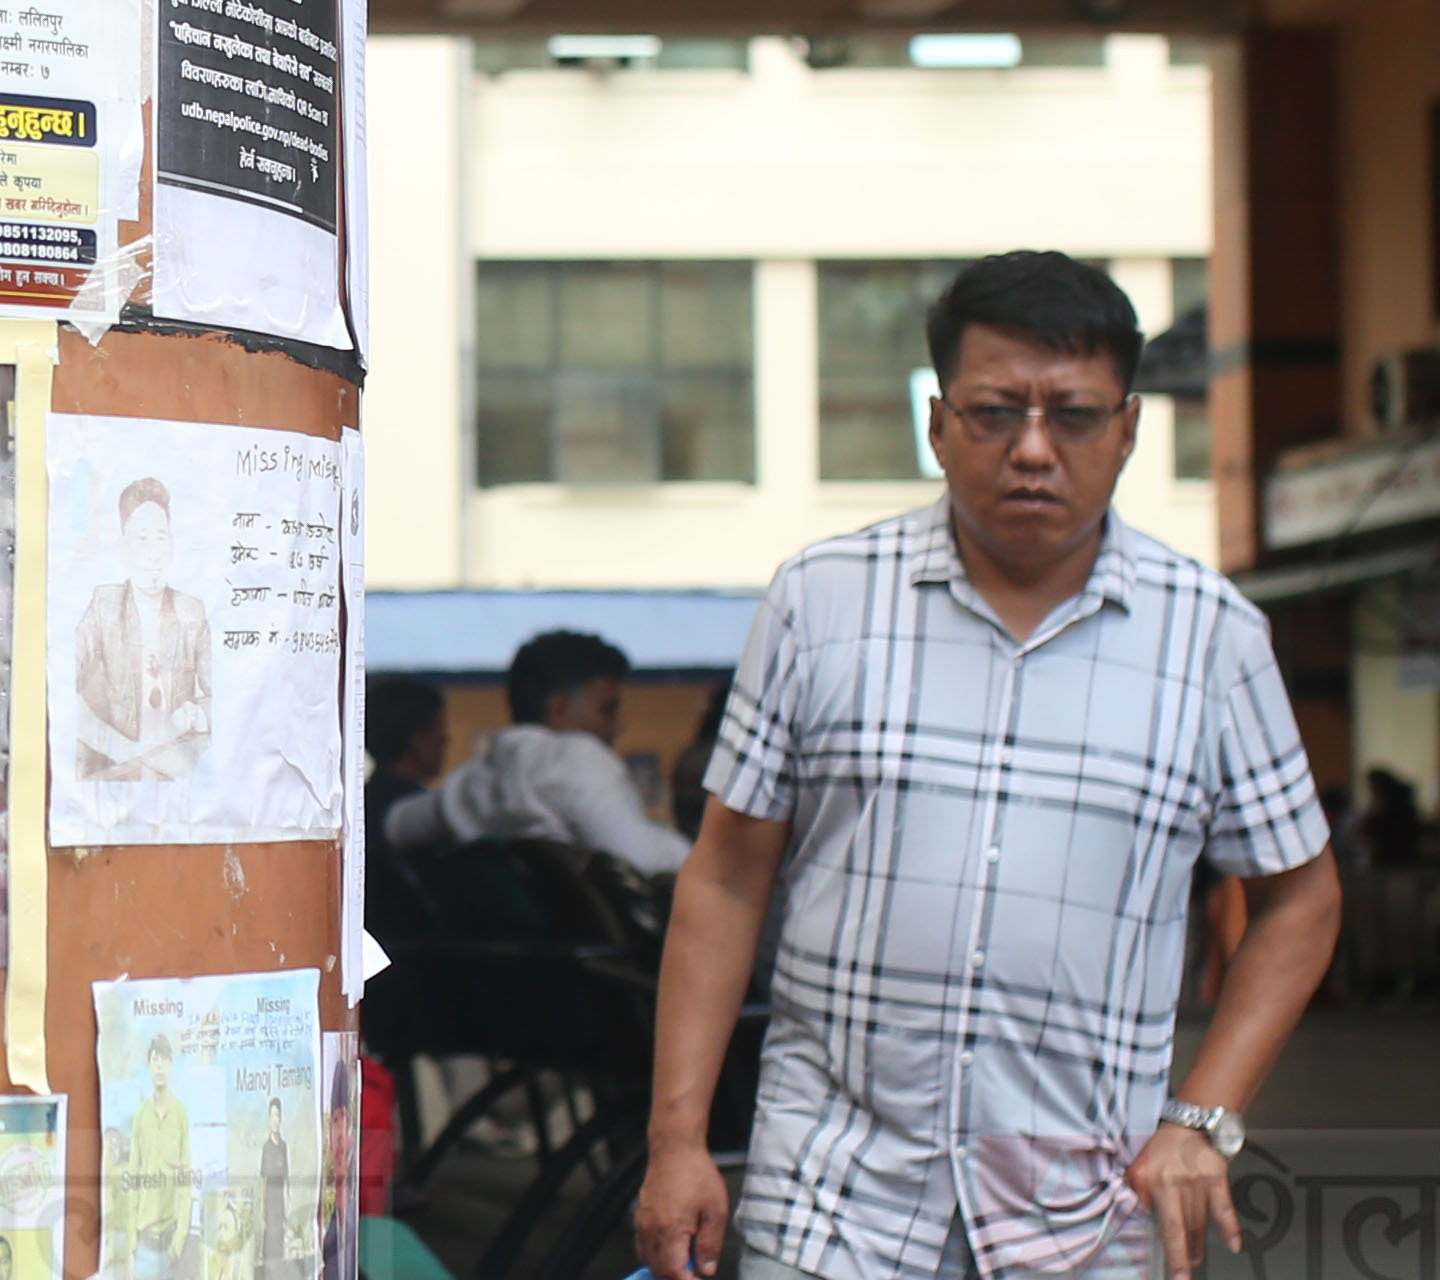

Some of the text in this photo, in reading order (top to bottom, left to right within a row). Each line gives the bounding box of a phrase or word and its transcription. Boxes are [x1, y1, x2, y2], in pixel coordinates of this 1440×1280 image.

[18, 7, 63, 36] ललितपुर
[28, 34, 89, 59] नगरपालिका
[41, 64, 49, 80] ७
[133, 1000, 184, 1018] Missing
[257, 998, 290, 1014] Missing
[236, 1064, 312, 1096] Manoj Tamang
